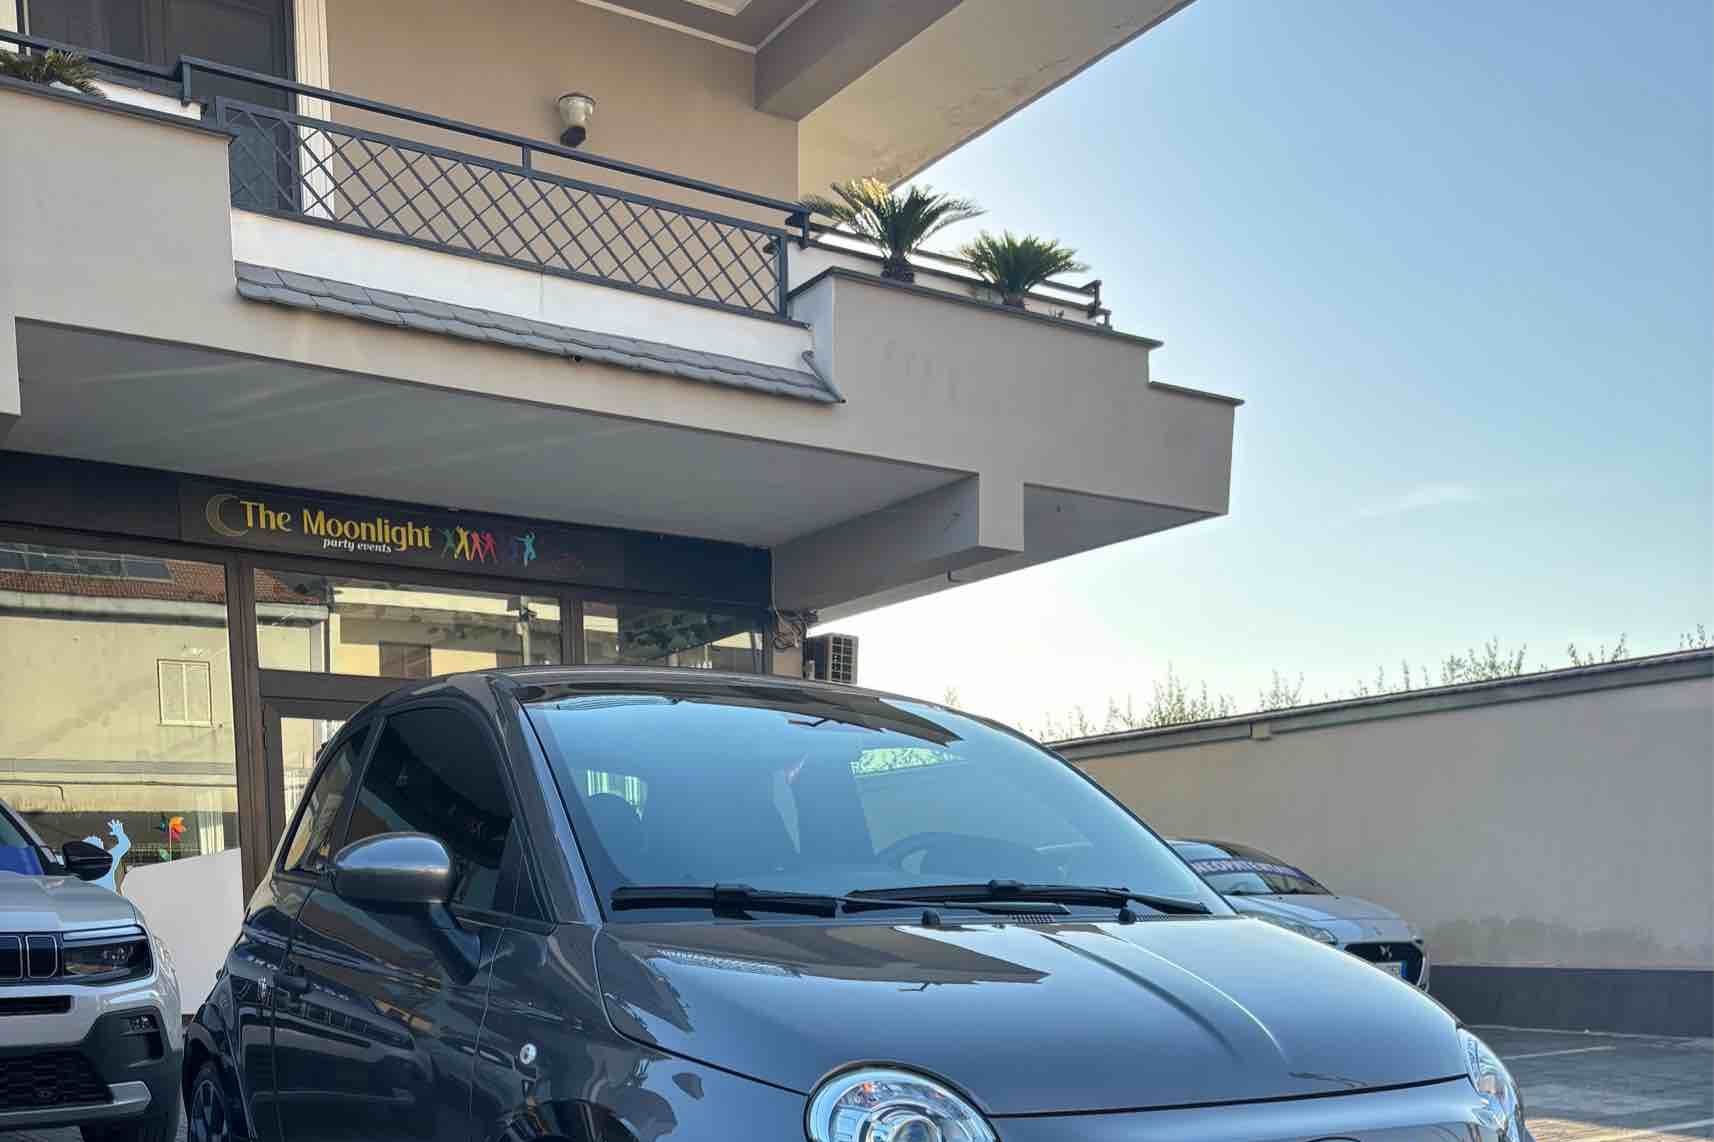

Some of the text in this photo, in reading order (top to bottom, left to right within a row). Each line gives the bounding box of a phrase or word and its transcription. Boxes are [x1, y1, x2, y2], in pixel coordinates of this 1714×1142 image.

[240, 500, 432, 551] The Moonlight
[322, 537, 392, 553] party events
